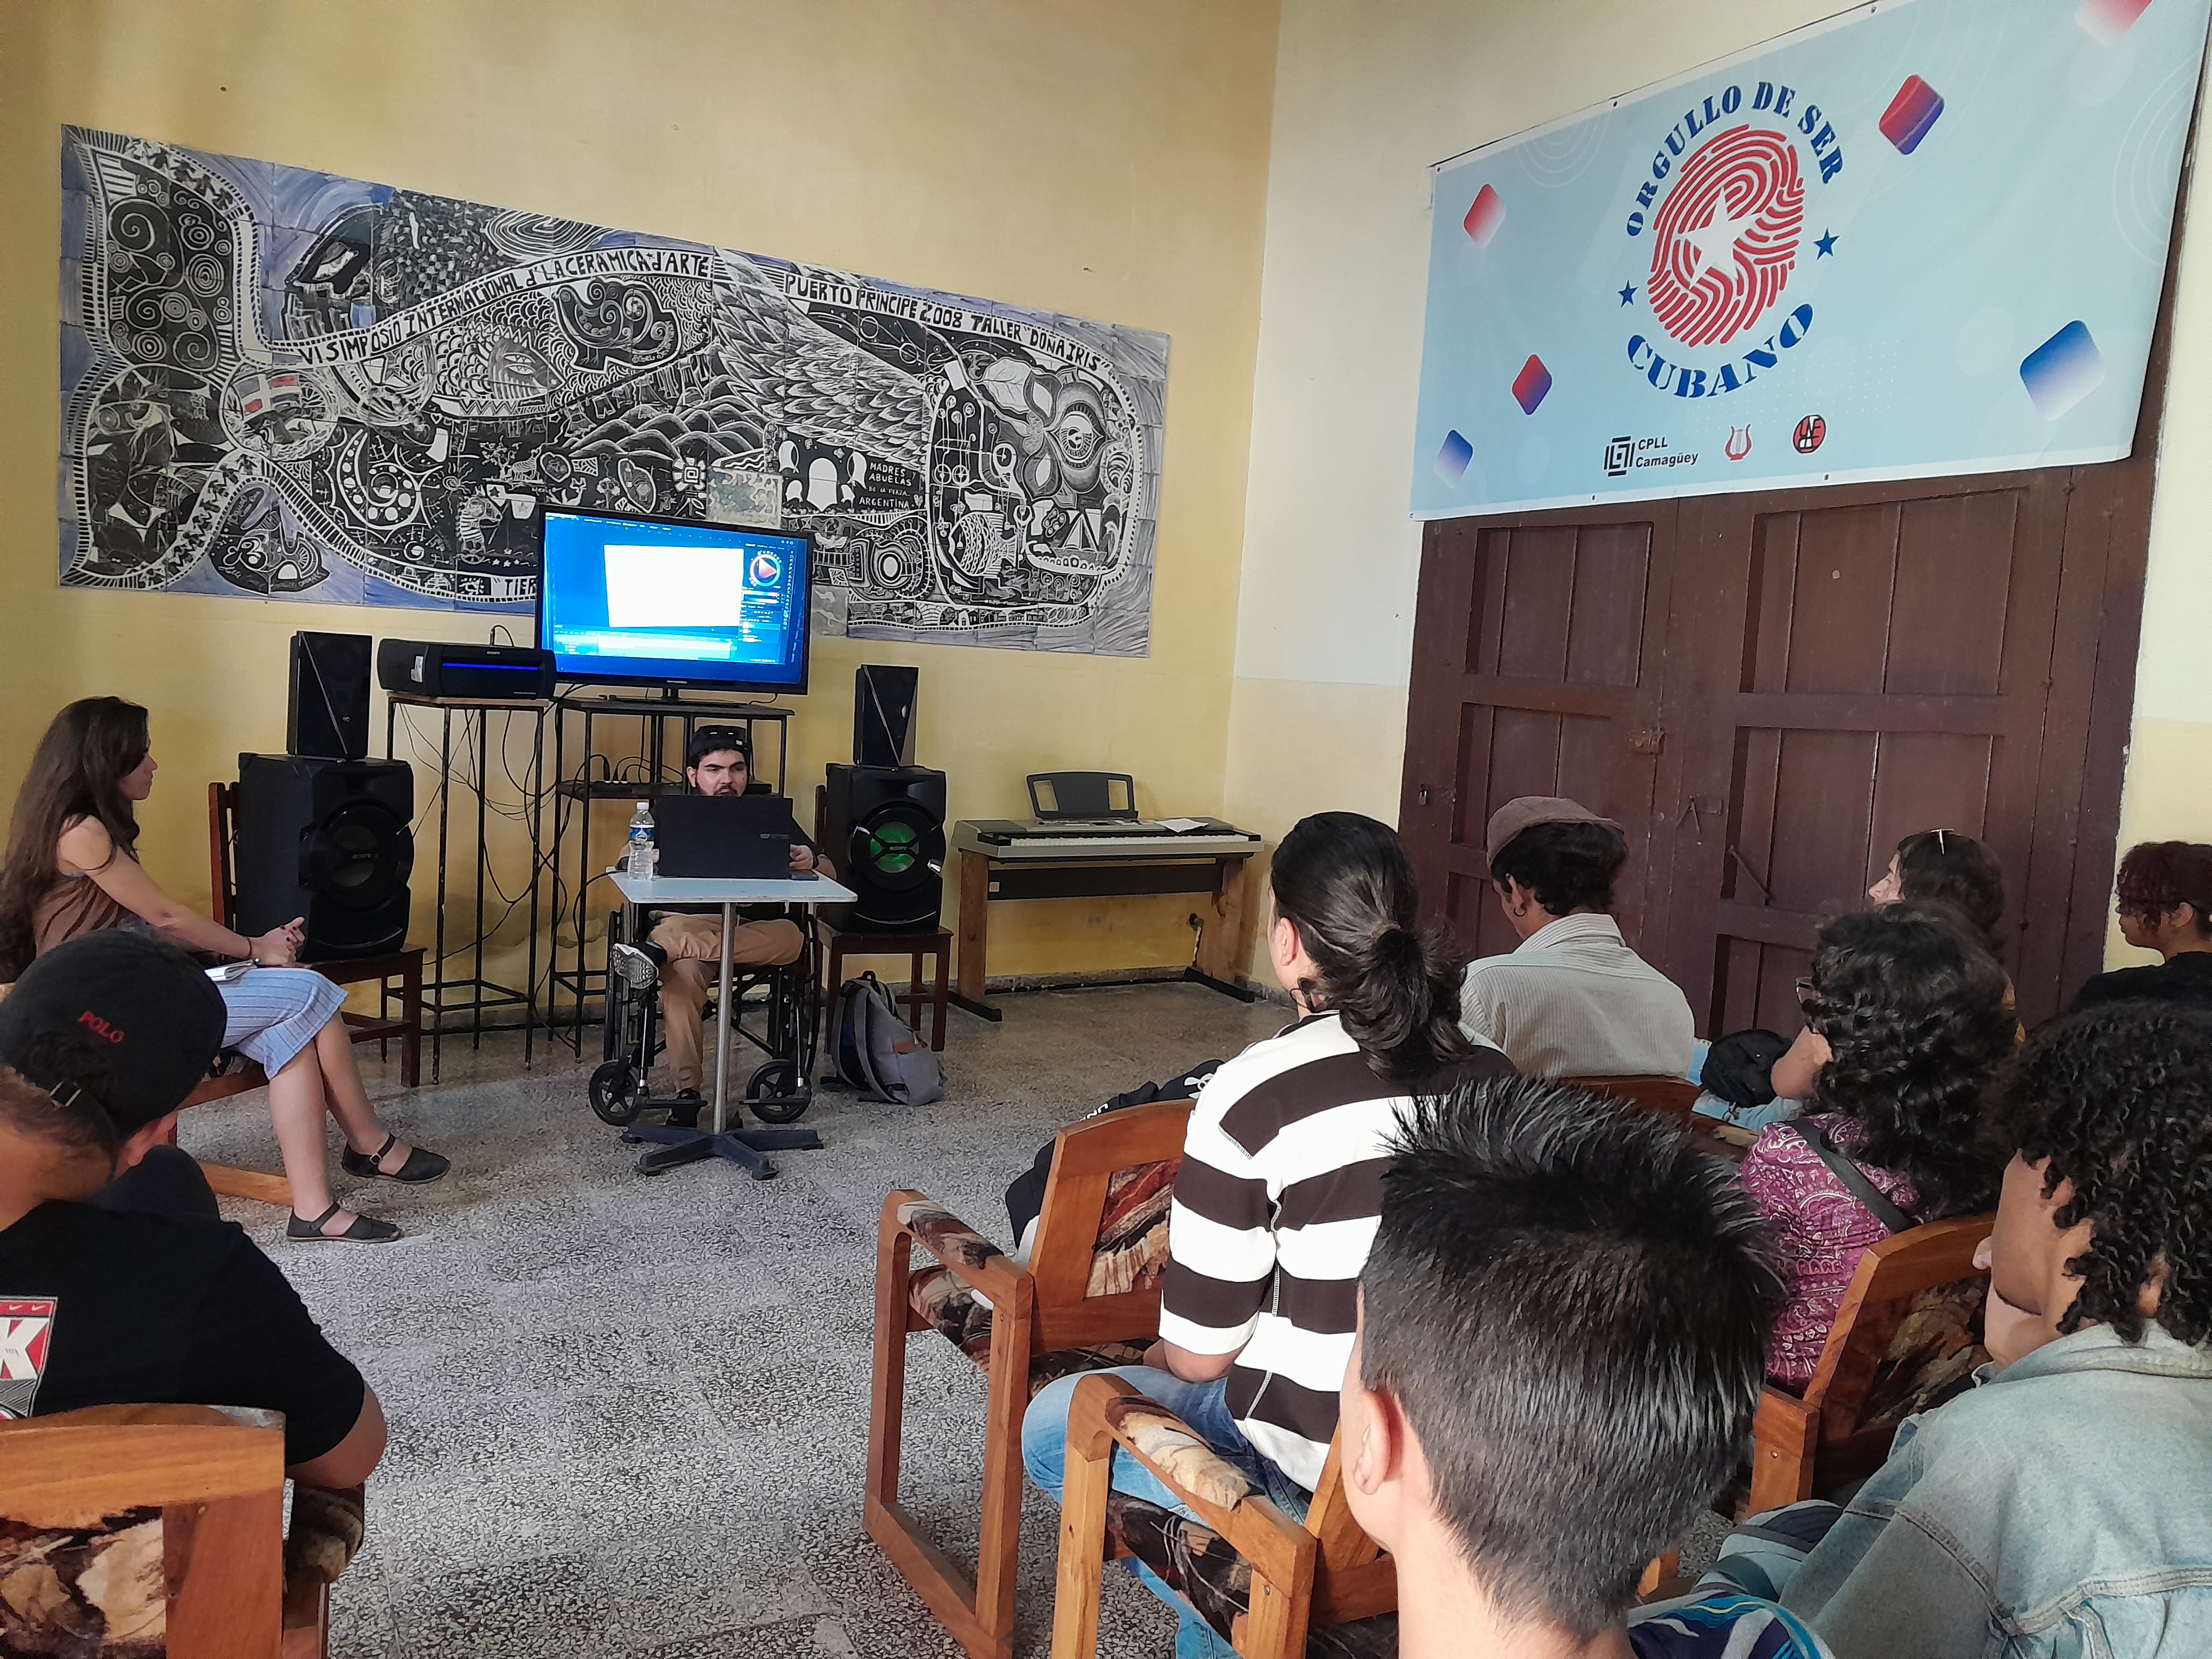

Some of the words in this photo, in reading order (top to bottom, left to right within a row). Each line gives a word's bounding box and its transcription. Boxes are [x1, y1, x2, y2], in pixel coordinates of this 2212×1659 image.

[1626, 85, 1741, 236] ORGULLO
[1752, 80, 1796, 119] DE
[1797, 105, 1844, 185] SER
[786, 274, 852, 305] PUERTO
[856, 288, 918, 318] PRINCIPE
[919, 304, 963, 328] 2008
[970, 314, 1022, 342] TALLER
[1627, 303, 1814, 399] CUBANO
[1638, 436, 1668, 451] CPLL
[870, 461, 906, 477] MADRES
[1636, 453, 1699, 468] Camagüey
[869, 473, 912, 486] ABUELAS
[78, 1011, 125, 1043] POLO
